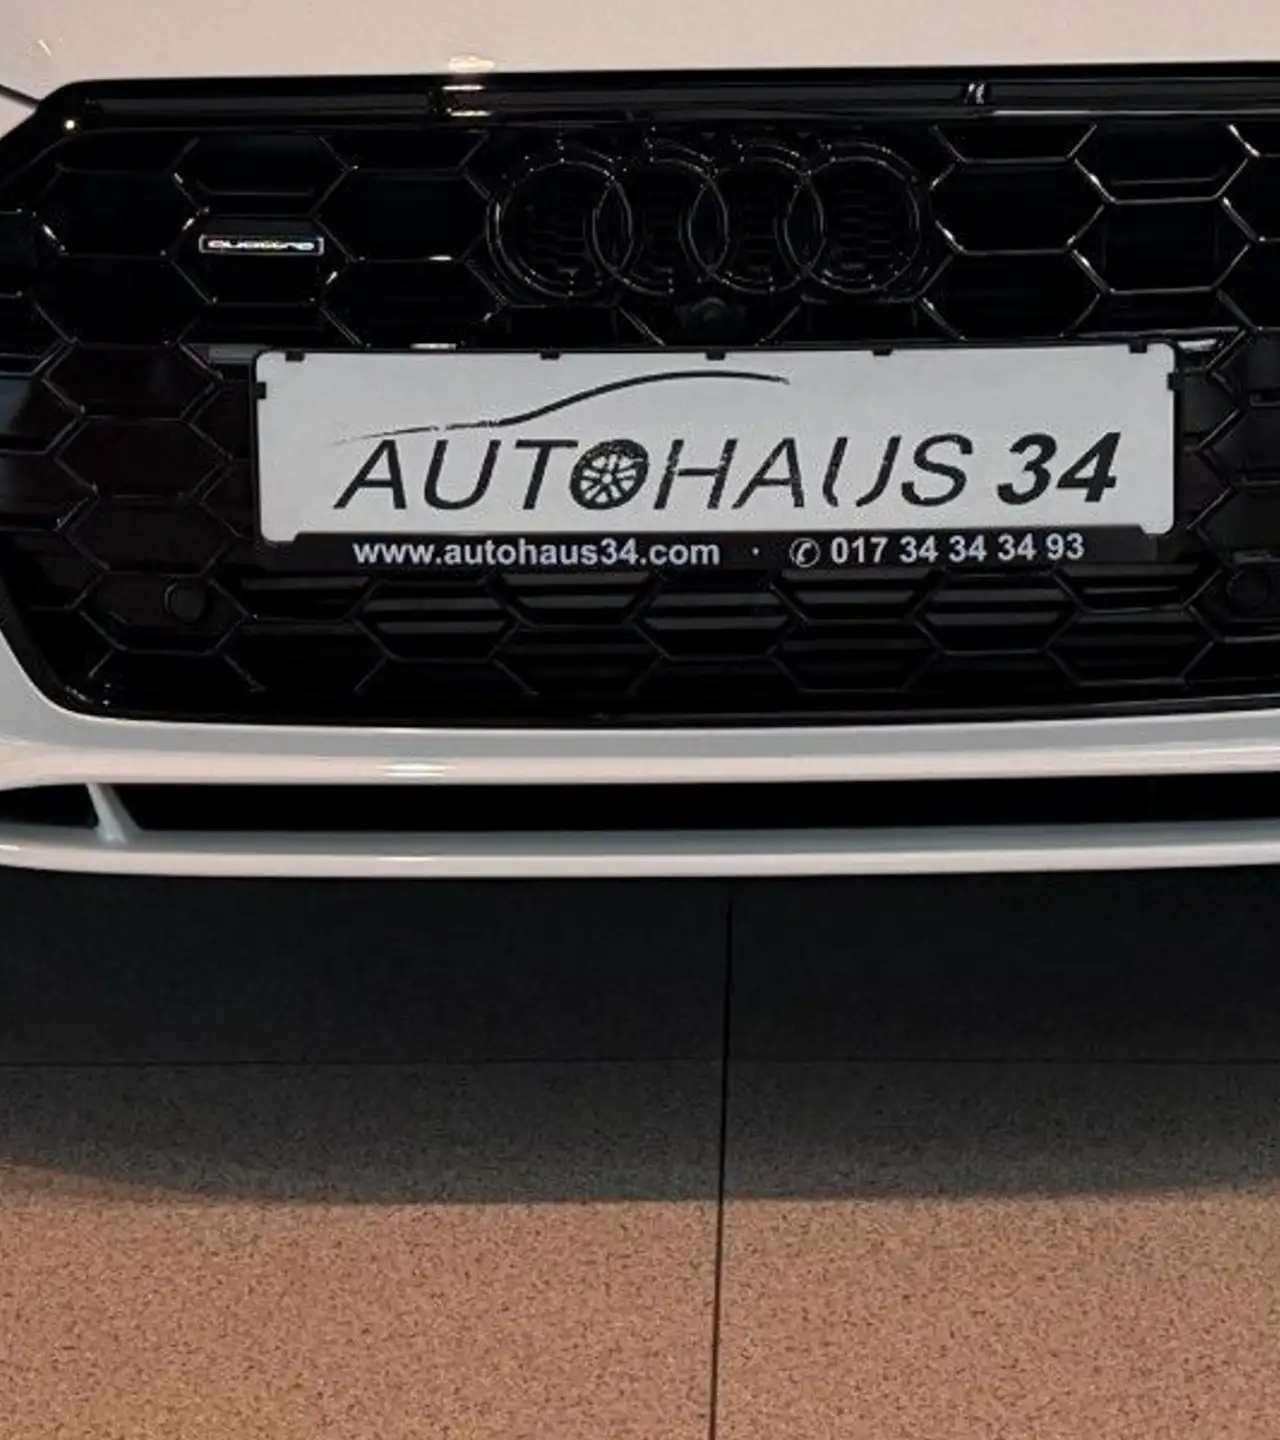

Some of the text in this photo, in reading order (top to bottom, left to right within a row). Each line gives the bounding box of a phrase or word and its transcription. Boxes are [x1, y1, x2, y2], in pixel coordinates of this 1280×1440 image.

[332, 431, 1122, 511] AUTOHAUS 34
[352, 532, 1084, 566] www.autohaus34.com 017 34 34 34 93
